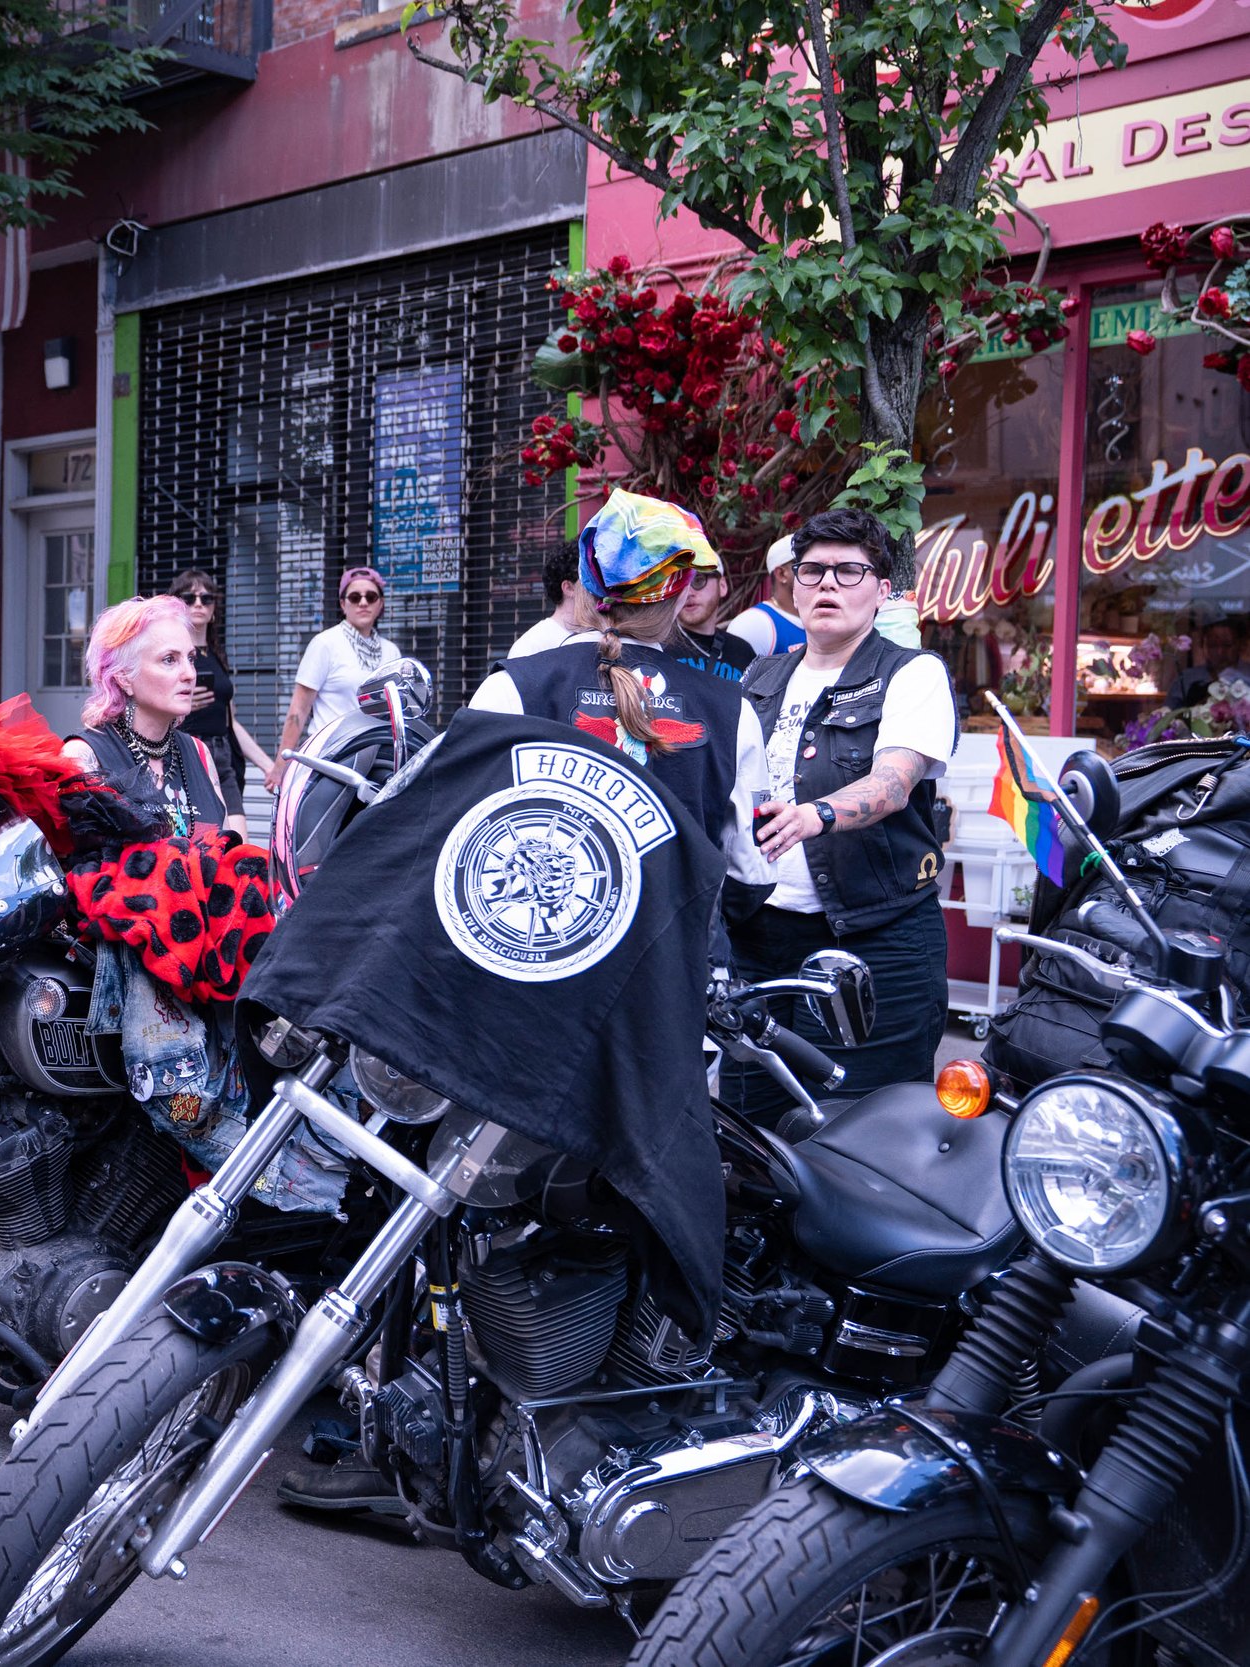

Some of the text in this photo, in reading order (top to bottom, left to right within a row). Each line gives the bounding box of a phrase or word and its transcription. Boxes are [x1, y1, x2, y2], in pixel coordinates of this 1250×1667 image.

[62, 453, 92, 483] 172
[580, 691, 617, 706] SIRE
[835, 692, 854, 702] ROAD
[536, 753, 656, 829] HOMOTO
[461, 910, 548, 963] LIVE DELICIOUSLY
[37, 1020, 90, 1066] BOLT
